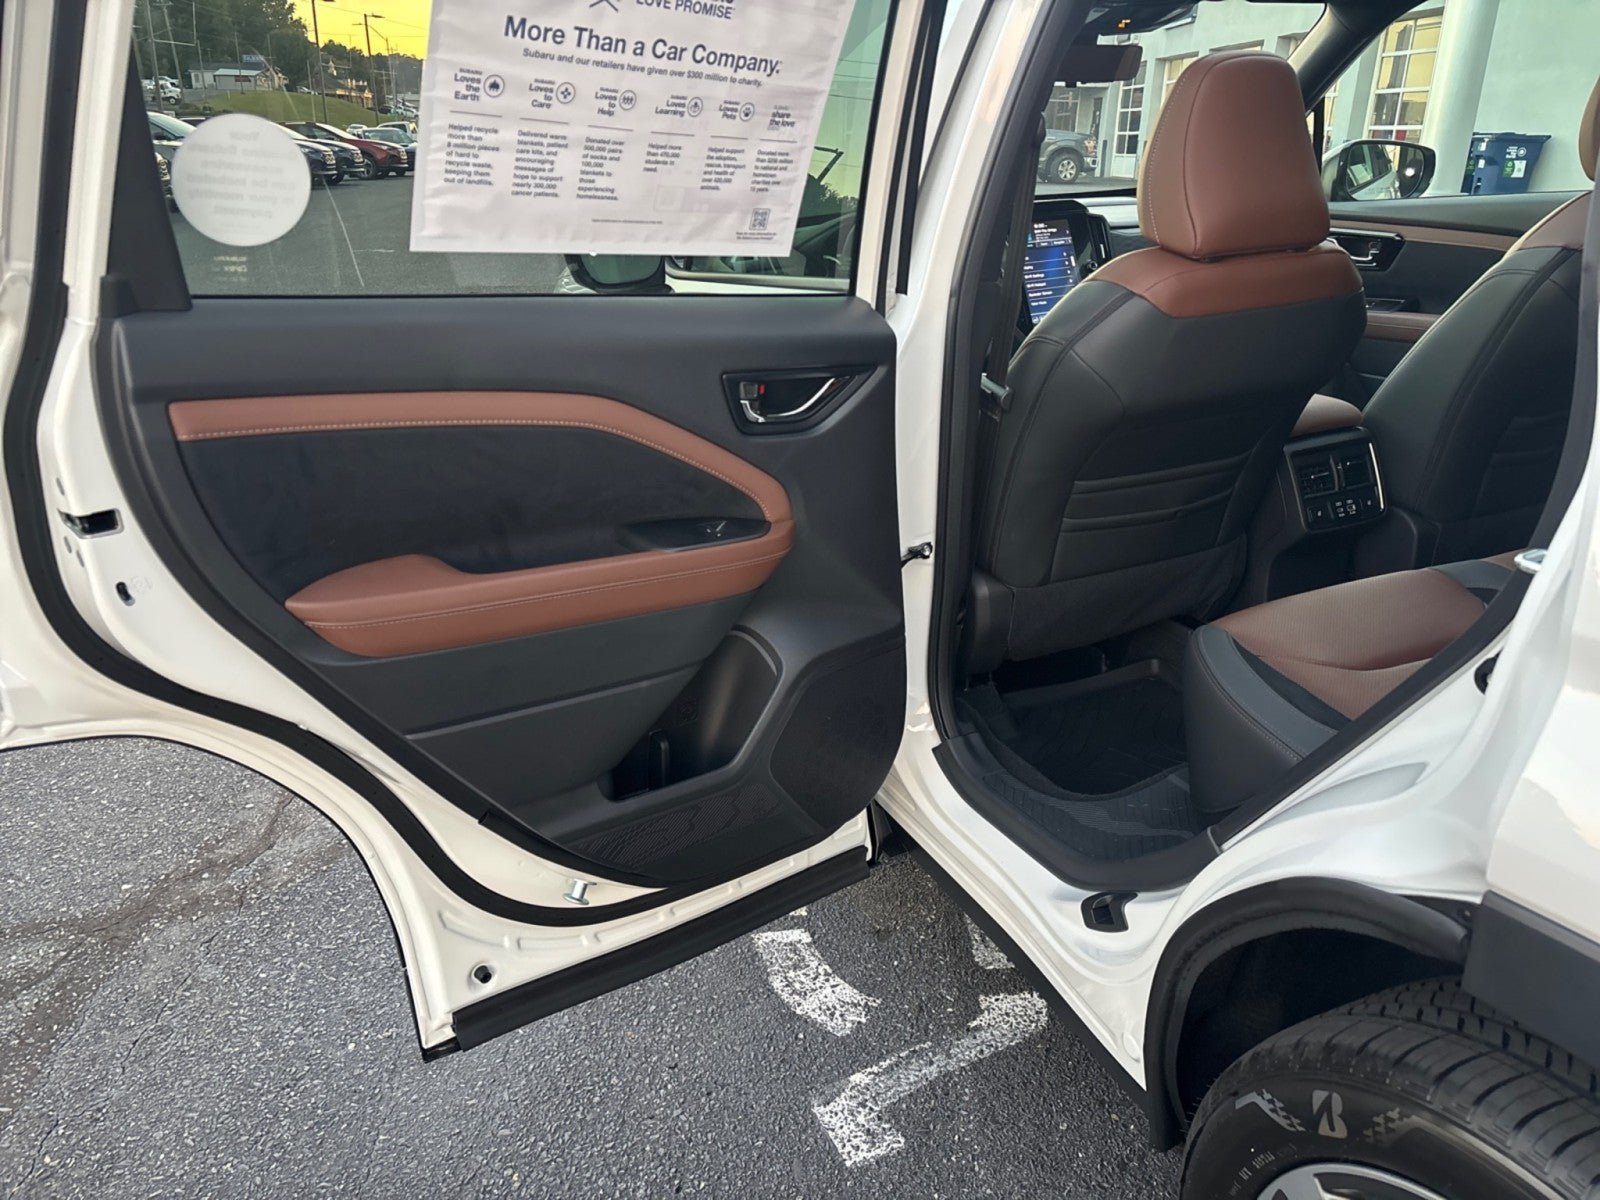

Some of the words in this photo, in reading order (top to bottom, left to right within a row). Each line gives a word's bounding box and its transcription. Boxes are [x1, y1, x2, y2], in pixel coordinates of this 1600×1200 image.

[674, 0, 732, 19] PROMISE
[504, 15, 566, 45] More
[574, 26, 626, 54] Than
[632, 40, 646, 57] a
[651, 38, 687, 62] Car
[692, 44, 780, 77] Company.
[522, 48, 555, 61] Subaru
[557, 52, 574, 64] and
[576, 56, 590, 66] our
[592, 57, 625, 71] retailers
[626, 62, 645, 74] have
[647, 66, 668, 77] given
[669, 69, 686, 78] over
[687, 70, 704, 80] $300
[704, 72, 728, 83] million
[730, 76, 737, 84] to
[738, 77, 763, 88] charity.
[454, 73, 481, 84] Loves
[465, 84, 480, 93] the
[528, 84, 554, 94] Loves
[454, 90, 480, 101] Earth
[595, 92, 618, 101] Loves
[531, 100, 552, 109] Care
[666, 100, 686, 108] Loves
[597, 108, 614, 117] Help
[655, 106, 686, 118] Learning
[719, 105, 738, 113] Loves
[722, 112, 736, 120] Pets
[772, 111, 791, 119] share
[770, 118, 780, 126] the
[781, 118, 795, 127] love
[448, 124, 472, 132] Helped
[474, 126, 498, 134] recycle
[518, 130, 548, 138] Delivered
[515, 157, 554, 166] encouraging
[445, 168, 472, 177] keeping
[514, 165, 546, 173] messages
